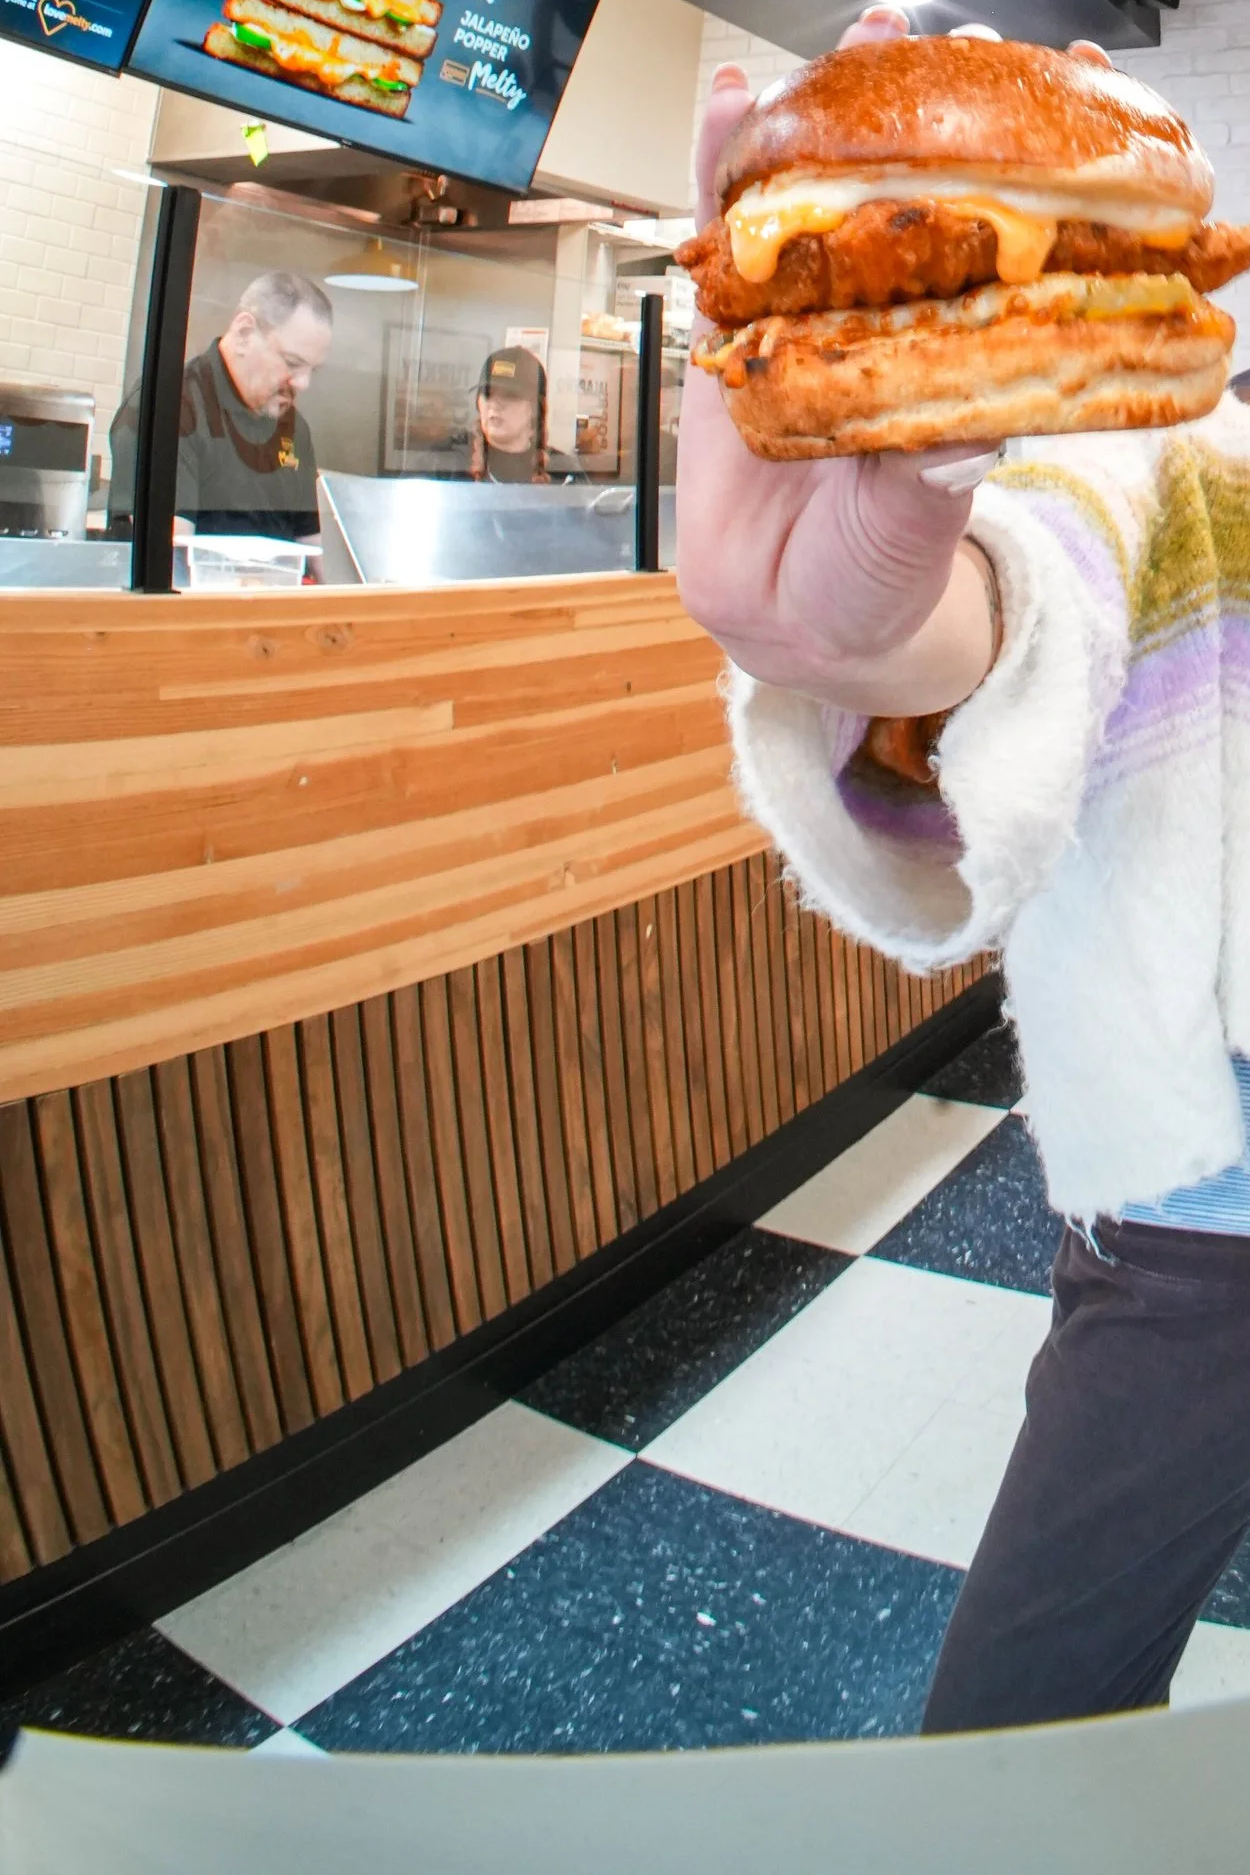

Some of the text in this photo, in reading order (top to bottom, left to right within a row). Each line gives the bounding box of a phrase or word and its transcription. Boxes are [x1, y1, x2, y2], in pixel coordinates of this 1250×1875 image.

[44, 3, 113, 37] lovemelty.com
[460, 10, 530, 50] JALAPEÑO
[453, 27, 508, 62] POPPER
[468, 60, 527, 110] Melty
